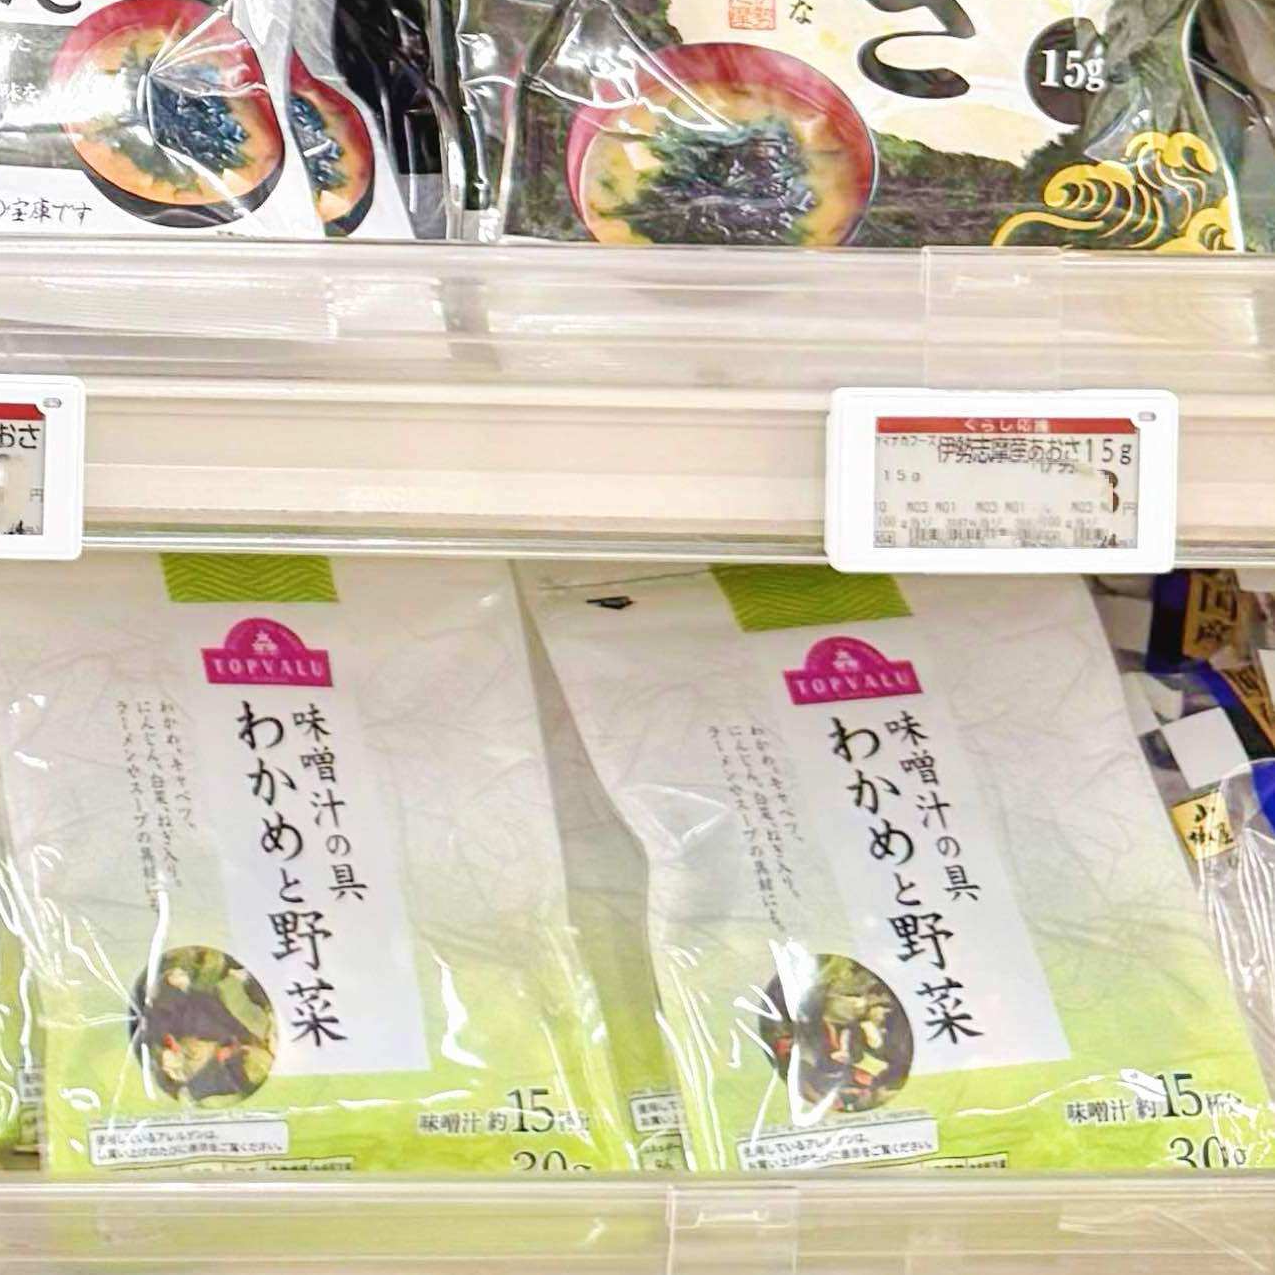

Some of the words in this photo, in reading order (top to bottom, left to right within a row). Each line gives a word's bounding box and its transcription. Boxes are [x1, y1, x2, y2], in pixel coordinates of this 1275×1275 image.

[1038, 47, 1107, 92] 15g
[213, 658, 324, 679] TOPVALU
[796, 671, 912, 696] TOPVALU
[292, 703, 368, 901] 味噌汁の具
[886, 711, 983, 903] 味噌汁の具
[235, 700, 348, 1047] わかめと野菜
[829, 716, 984, 1045] わかめと野菜
[419, 1112, 480, 1135] 味噌汁
[1067, 1100, 1130, 1124] 味噌汁
